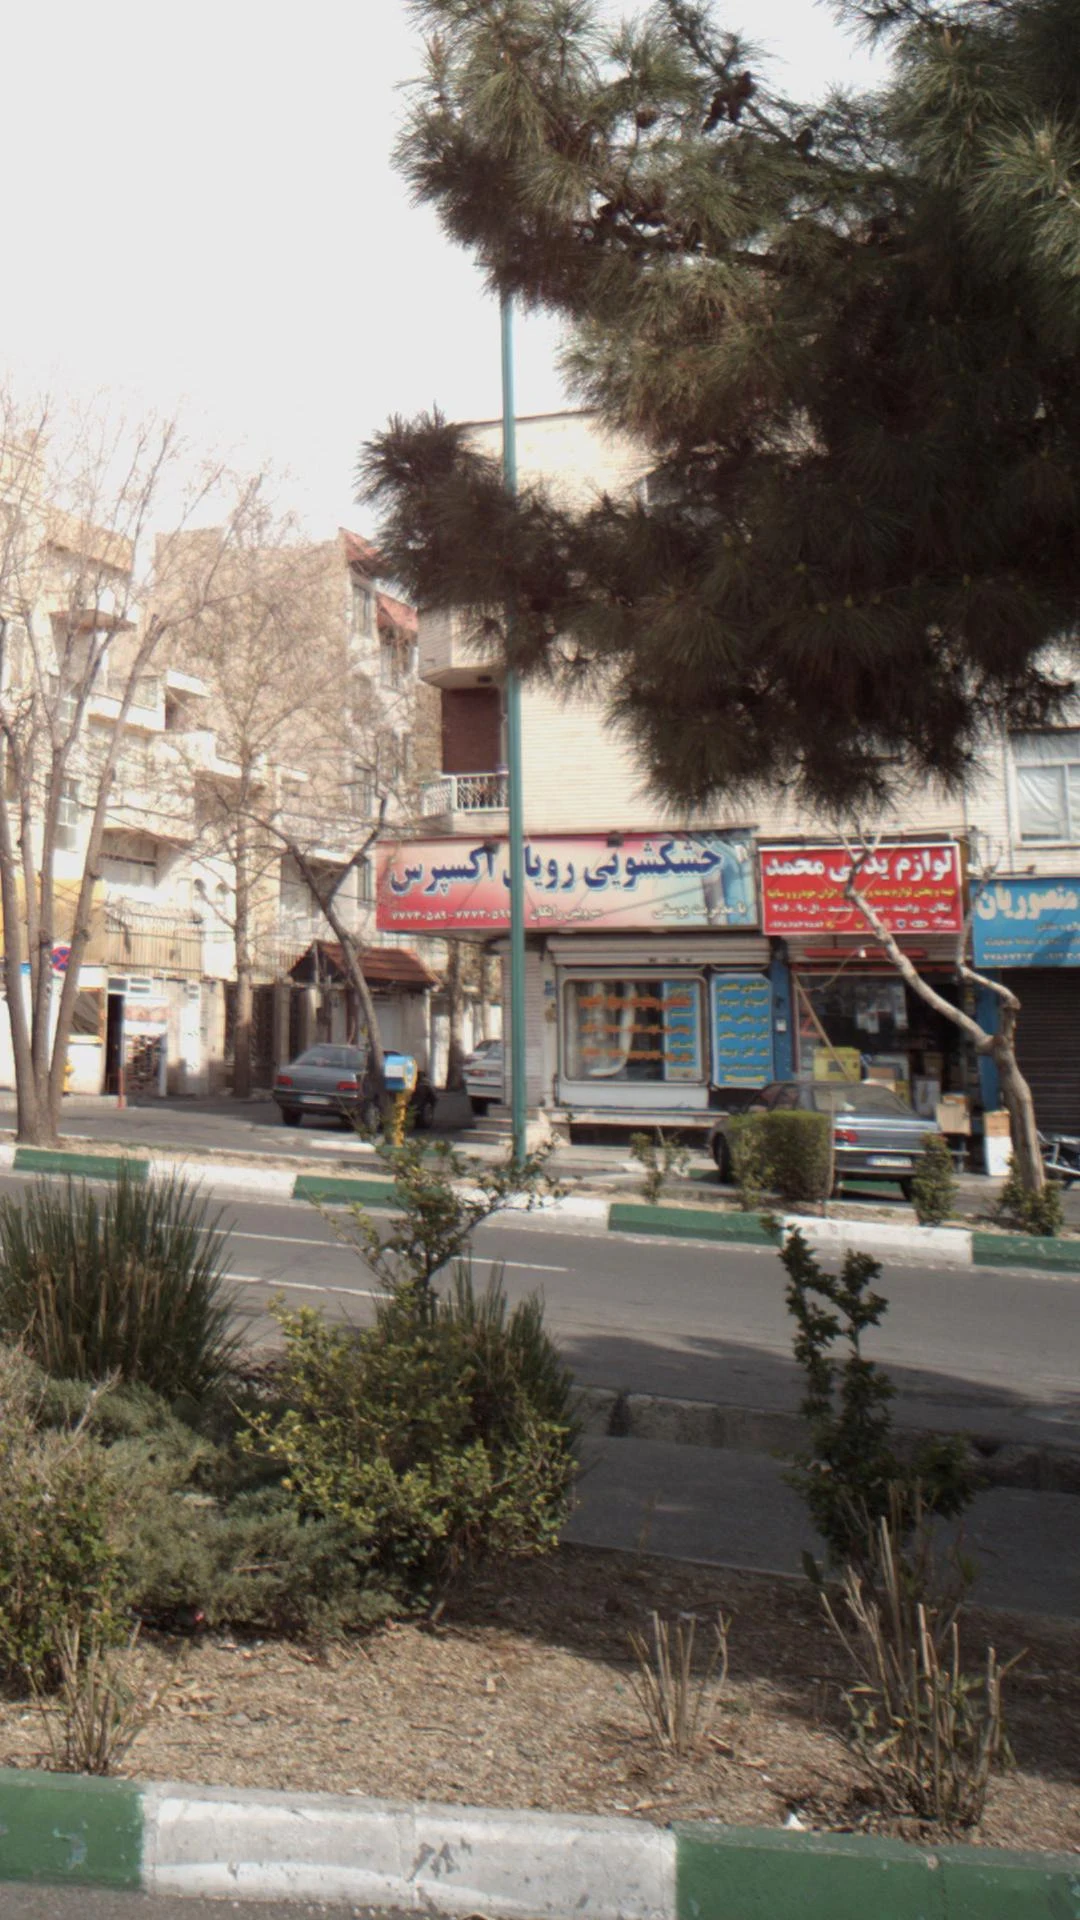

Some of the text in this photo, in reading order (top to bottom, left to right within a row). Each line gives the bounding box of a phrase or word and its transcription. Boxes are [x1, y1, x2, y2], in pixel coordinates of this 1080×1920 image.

[390, 843, 496, 893] اکسپرس
[584, 841, 721, 888] خشکشویی
[765, 857, 825, 876] محمد
[895, 849, 953, 881] لوازم
